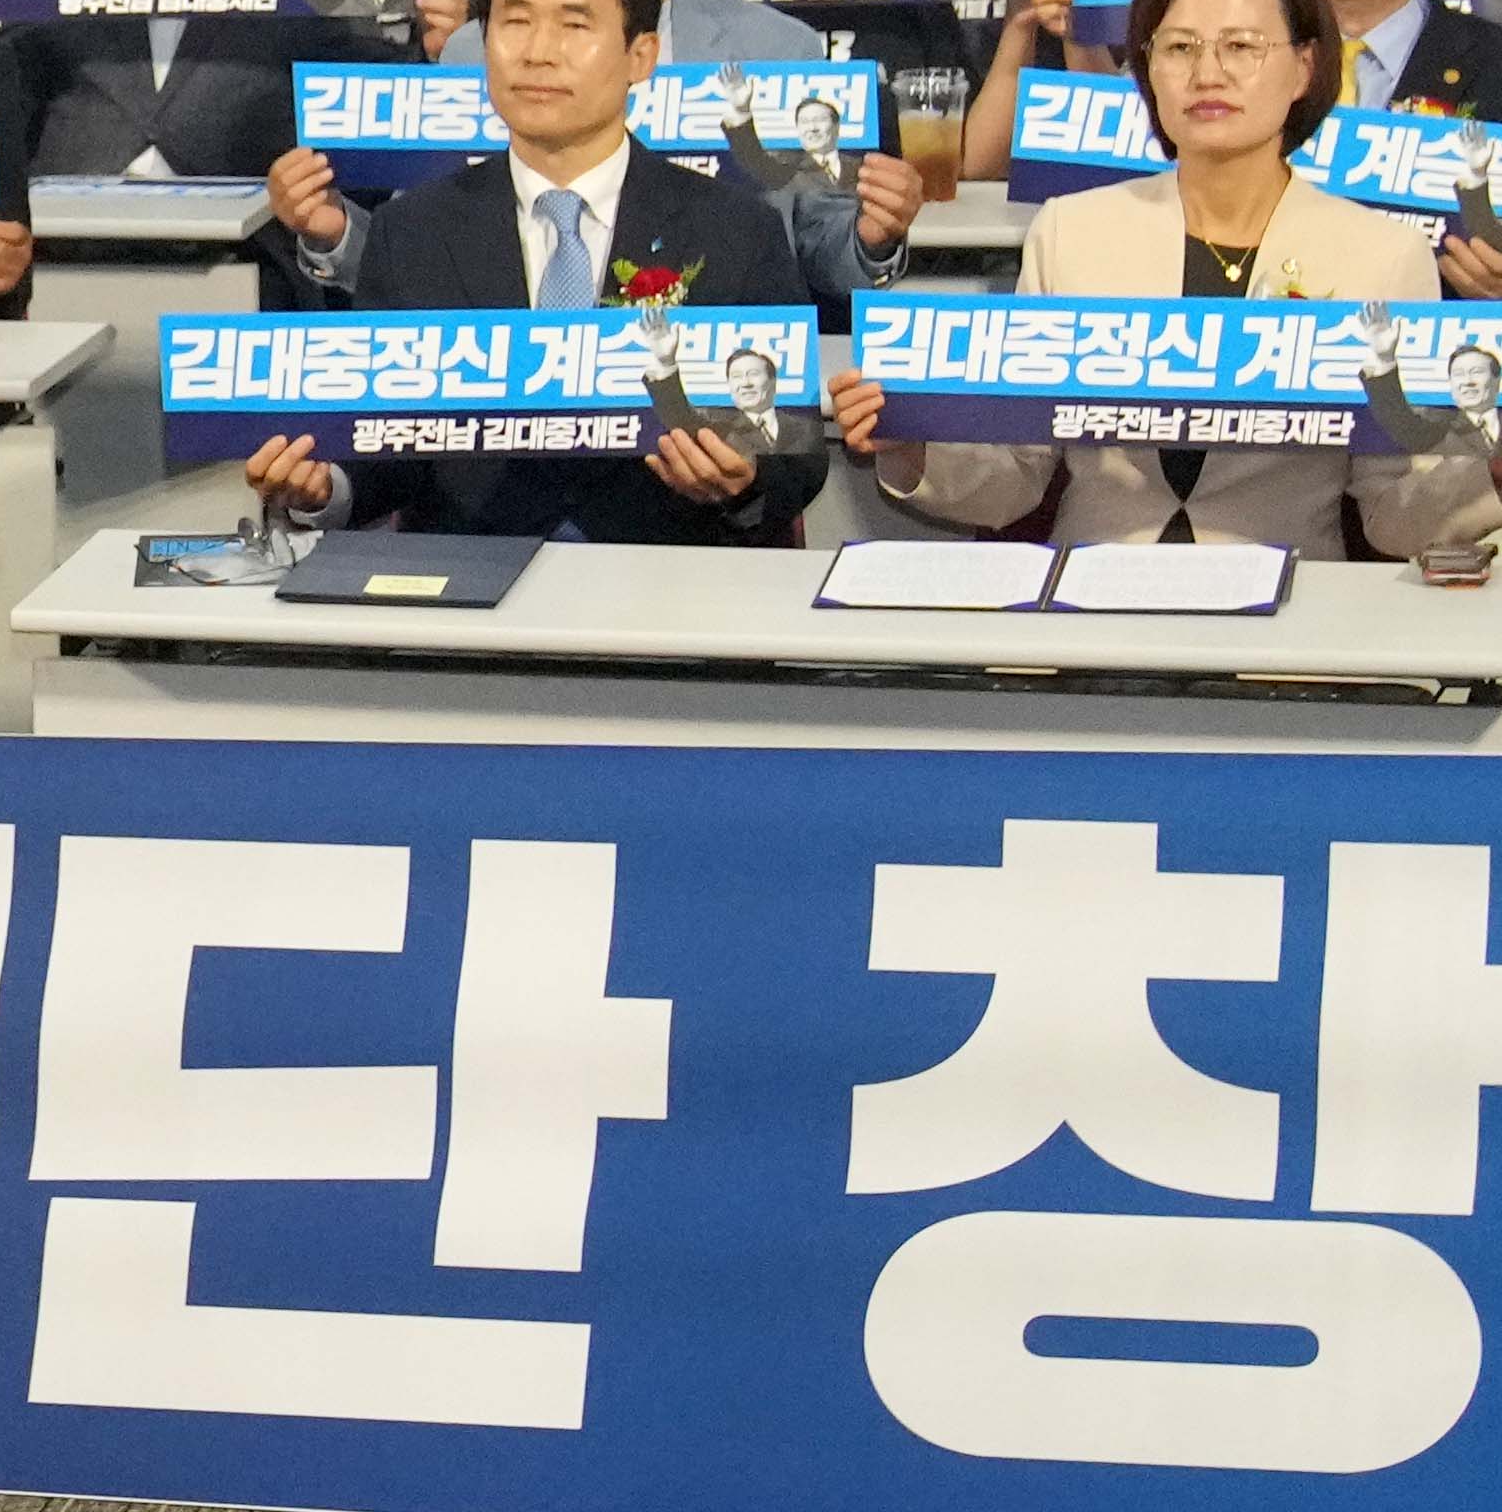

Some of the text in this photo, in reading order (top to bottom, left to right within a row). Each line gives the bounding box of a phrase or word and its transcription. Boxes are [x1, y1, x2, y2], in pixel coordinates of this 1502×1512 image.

[626, 75, 867, 138] 계승발전
[168, 321, 811, 400] 김대중정신 계승발전
[862, 306, 1223, 388] 김대중정신
[353, 414, 640, 453] 광주전남 김대중재단
[1053, 405, 1353, 446] 광주전남 김대중재단
